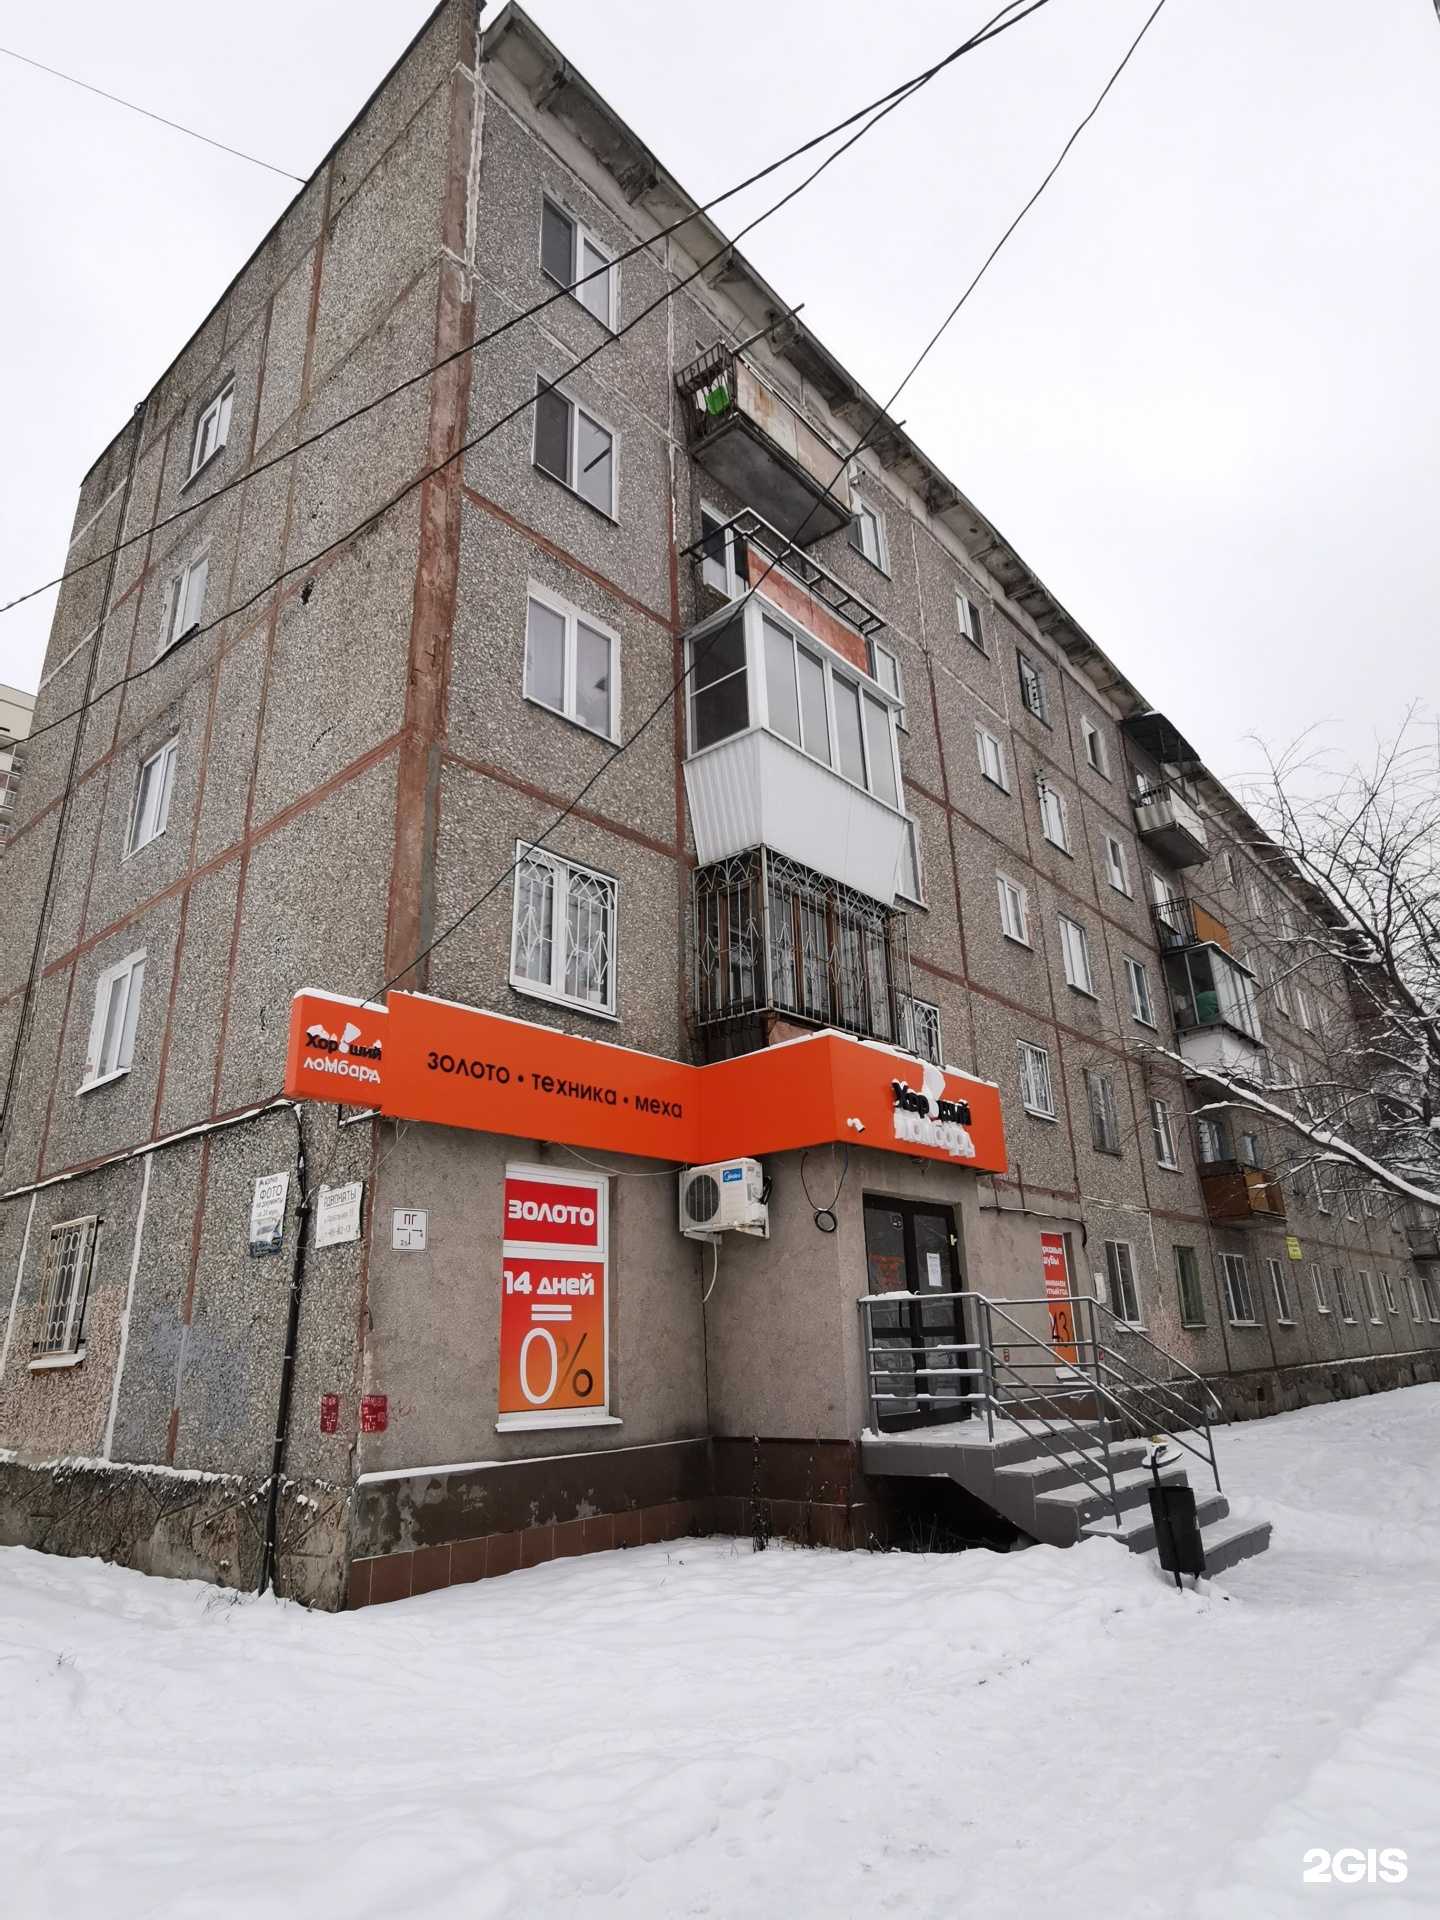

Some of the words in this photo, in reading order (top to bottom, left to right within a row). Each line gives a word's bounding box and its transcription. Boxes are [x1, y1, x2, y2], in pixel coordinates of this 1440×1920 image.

[303, 1055, 382, 1084] ломбард
[531, 1072, 617, 1106] техника
[634, 1094, 683, 1119] меха
[404, 1213, 417, 1225] ПГ
[503, 1270, 532, 1295] 14
